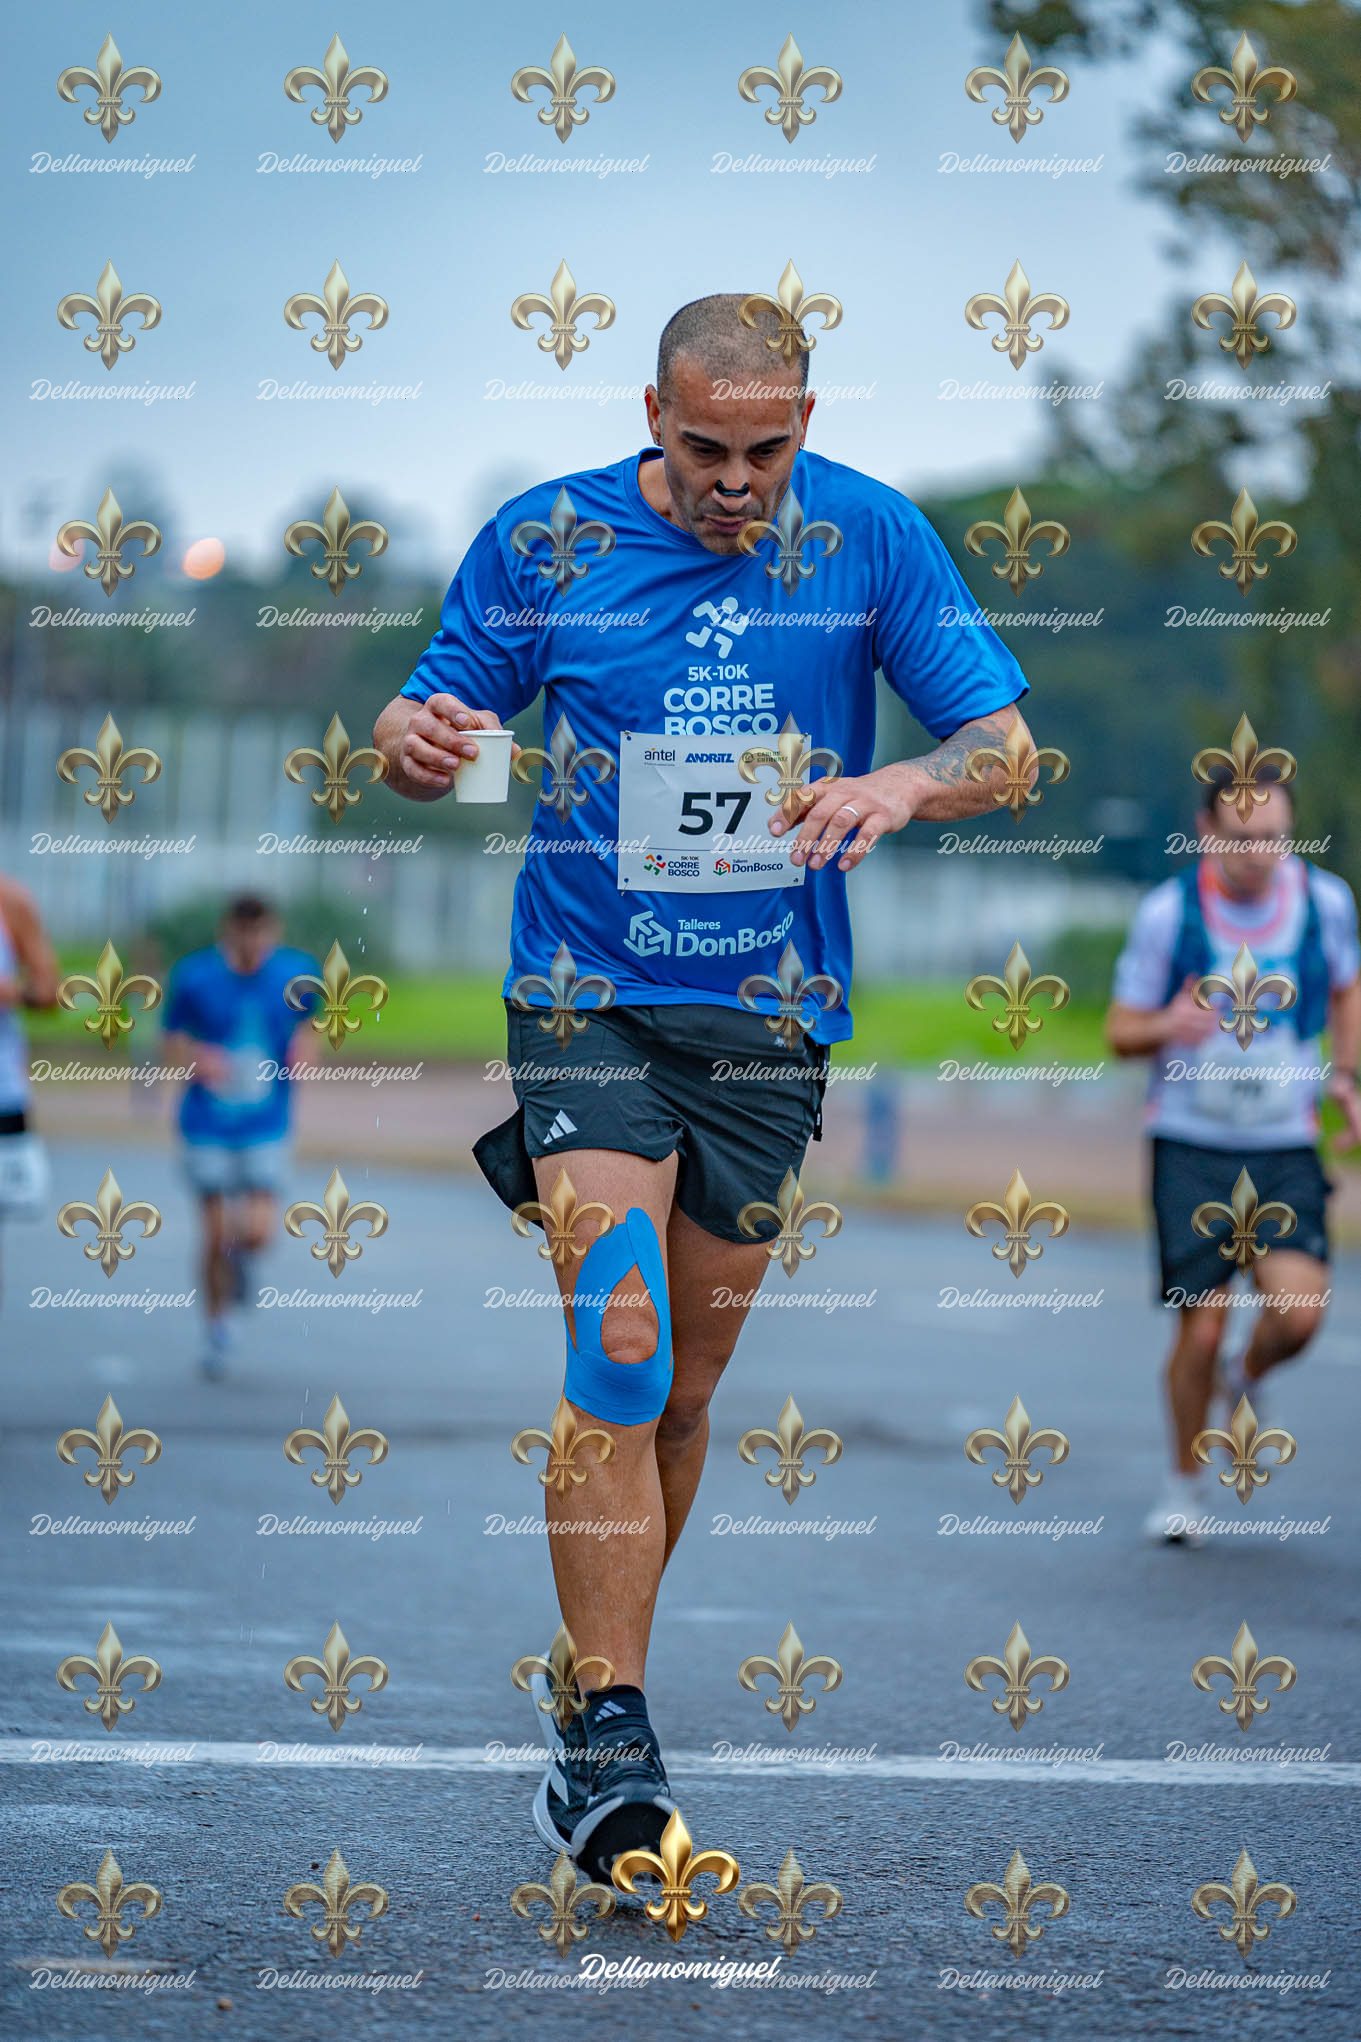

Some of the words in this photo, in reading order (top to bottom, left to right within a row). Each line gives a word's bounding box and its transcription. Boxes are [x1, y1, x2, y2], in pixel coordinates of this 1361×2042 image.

[688, 664, 749, 681] 5K-10K
[663, 683, 775, 713] CORRE
[664, 712, 778, 735] BOSCO
[644, 748, 676, 761] antel
[678, 791, 752, 835] 57
[668, 861, 700, 869] CORRE
[732, 862, 783, 873] DonBosco
[668, 869, 700, 877] BOSCO
[678, 919, 721, 931] Talleres
[675, 911, 794, 957] DonBosco
